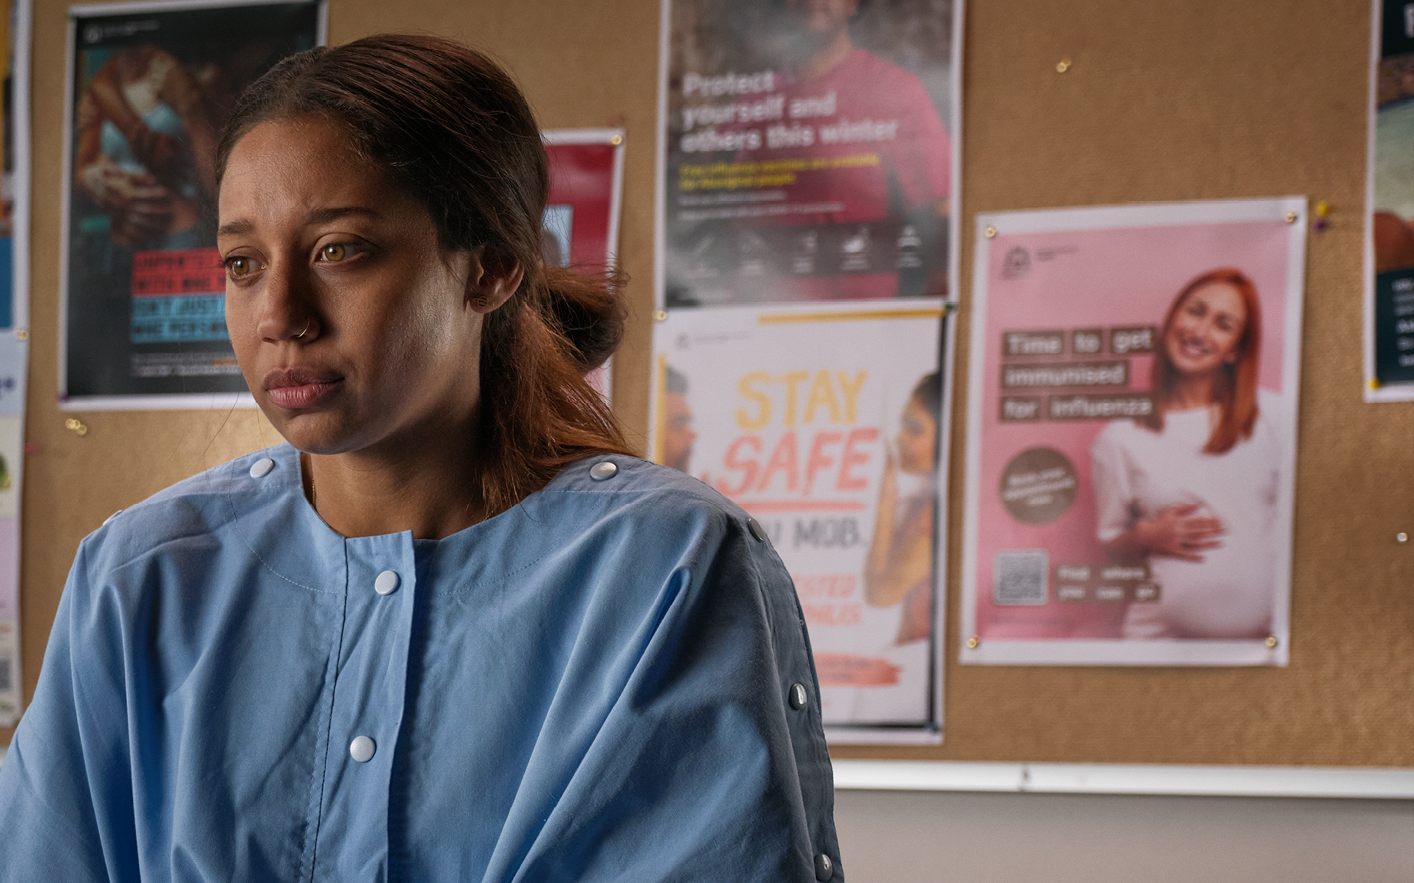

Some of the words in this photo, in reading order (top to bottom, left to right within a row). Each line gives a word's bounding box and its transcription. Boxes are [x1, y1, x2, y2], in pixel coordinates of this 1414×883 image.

[683, 70, 774, 96] Protect
[682, 94, 785, 130] yourself
[789, 91, 836, 118] and
[681, 129, 761, 152] others
[766, 122, 814, 148] this
[819, 119, 898, 143] winter
[1007, 334, 1061, 354] Time
[1074, 333, 1100, 352] to
[1113, 329, 1152, 353] get
[1005, 363, 1125, 386] immunised
[735, 369, 868, 431] STAY
[1004, 398, 1038, 419] for
[1051, 396, 1152, 417] influenza
[715, 427, 880, 497] SAFE
